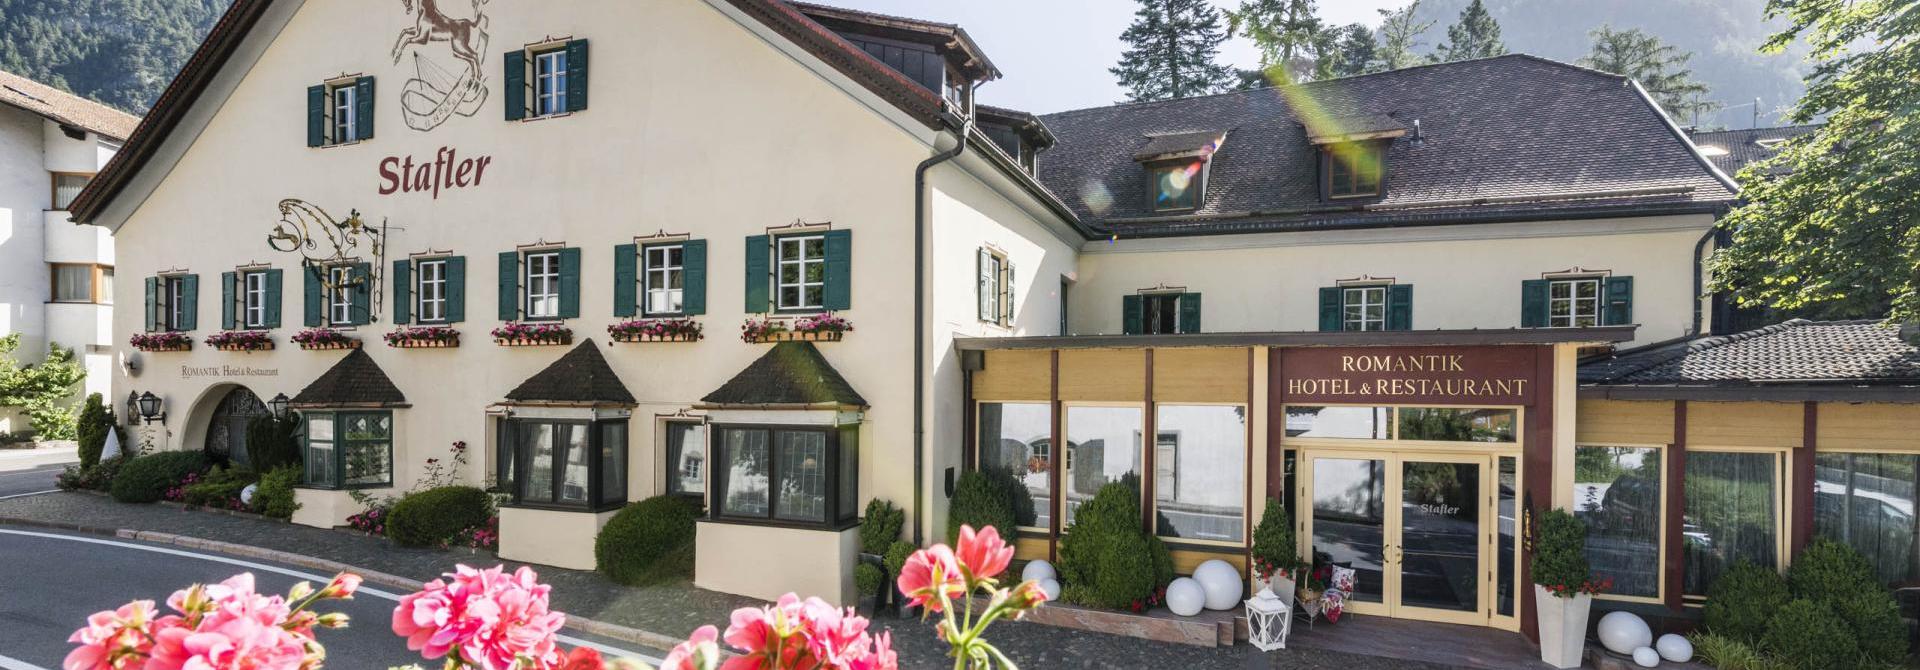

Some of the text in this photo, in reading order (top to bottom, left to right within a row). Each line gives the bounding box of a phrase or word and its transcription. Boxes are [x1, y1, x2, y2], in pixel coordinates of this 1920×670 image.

[378, 146, 491, 200] Stafler
[181, 365, 220, 377] ROMANTIK
[1342, 355, 1464, 372] ROMANTIK
[1288, 379, 1527, 396] HOTEL & RESTAURANT
[1420, 503, 1460, 515] Stafler
